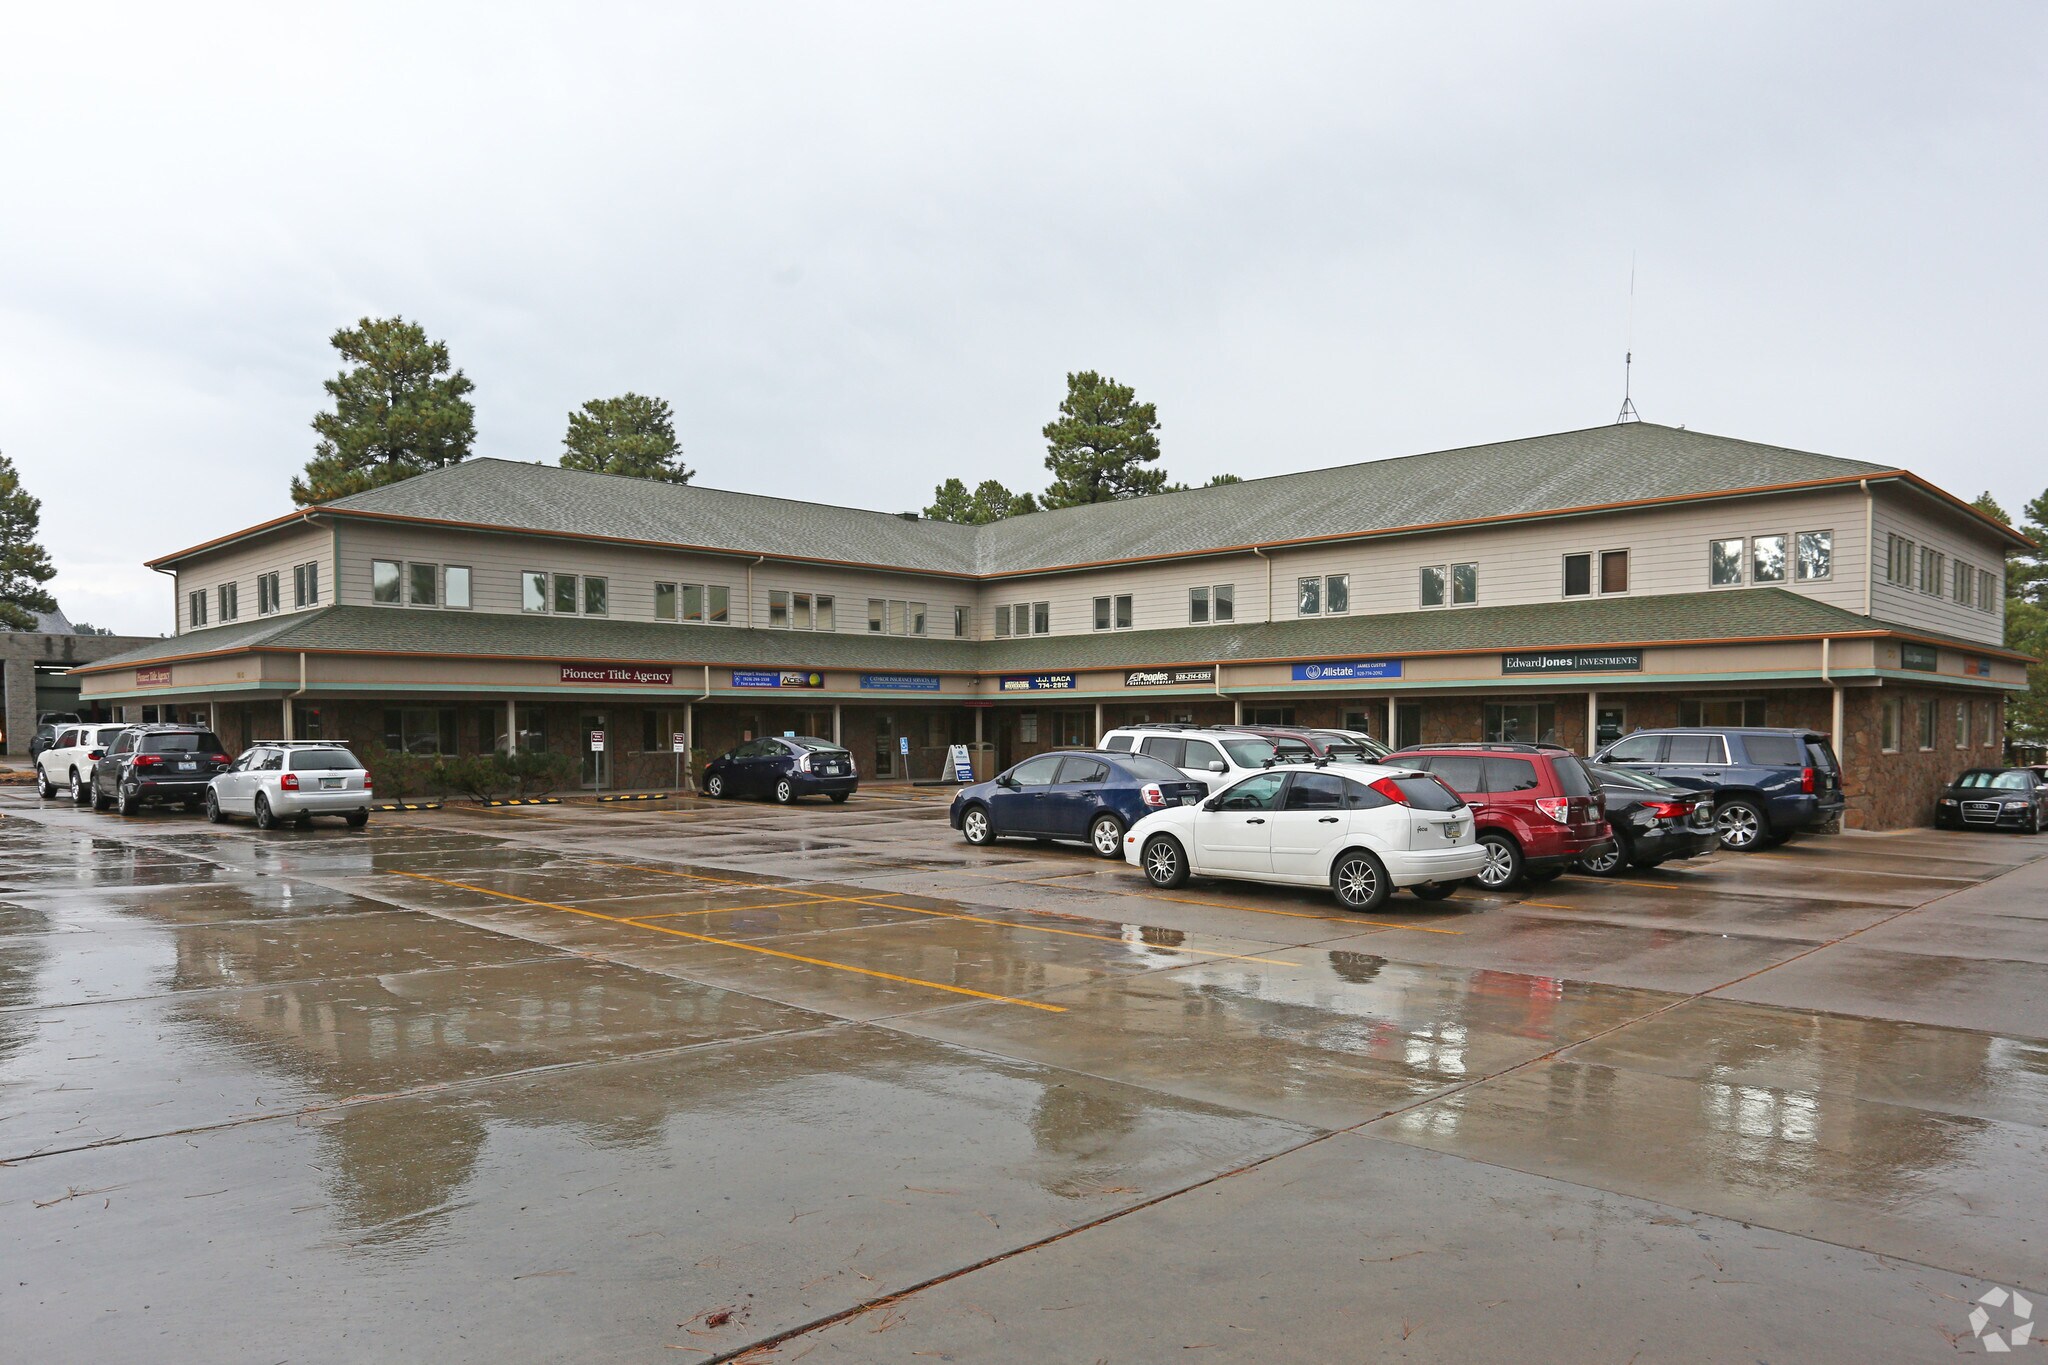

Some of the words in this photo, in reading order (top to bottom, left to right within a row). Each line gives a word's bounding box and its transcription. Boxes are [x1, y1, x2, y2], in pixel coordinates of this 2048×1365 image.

[1579, 656, 1638, 666] INVESTMENTS
[562, 668, 606, 679] Pioneer
[607, 669, 632, 680] Title
[633, 670, 671, 683] Agency
[1139, 671, 1169, 682] Peoples
[1321, 667, 1353, 677] Allstate
[782, 676, 804, 684] ACES
[1050, 675, 1071, 683] BACA
